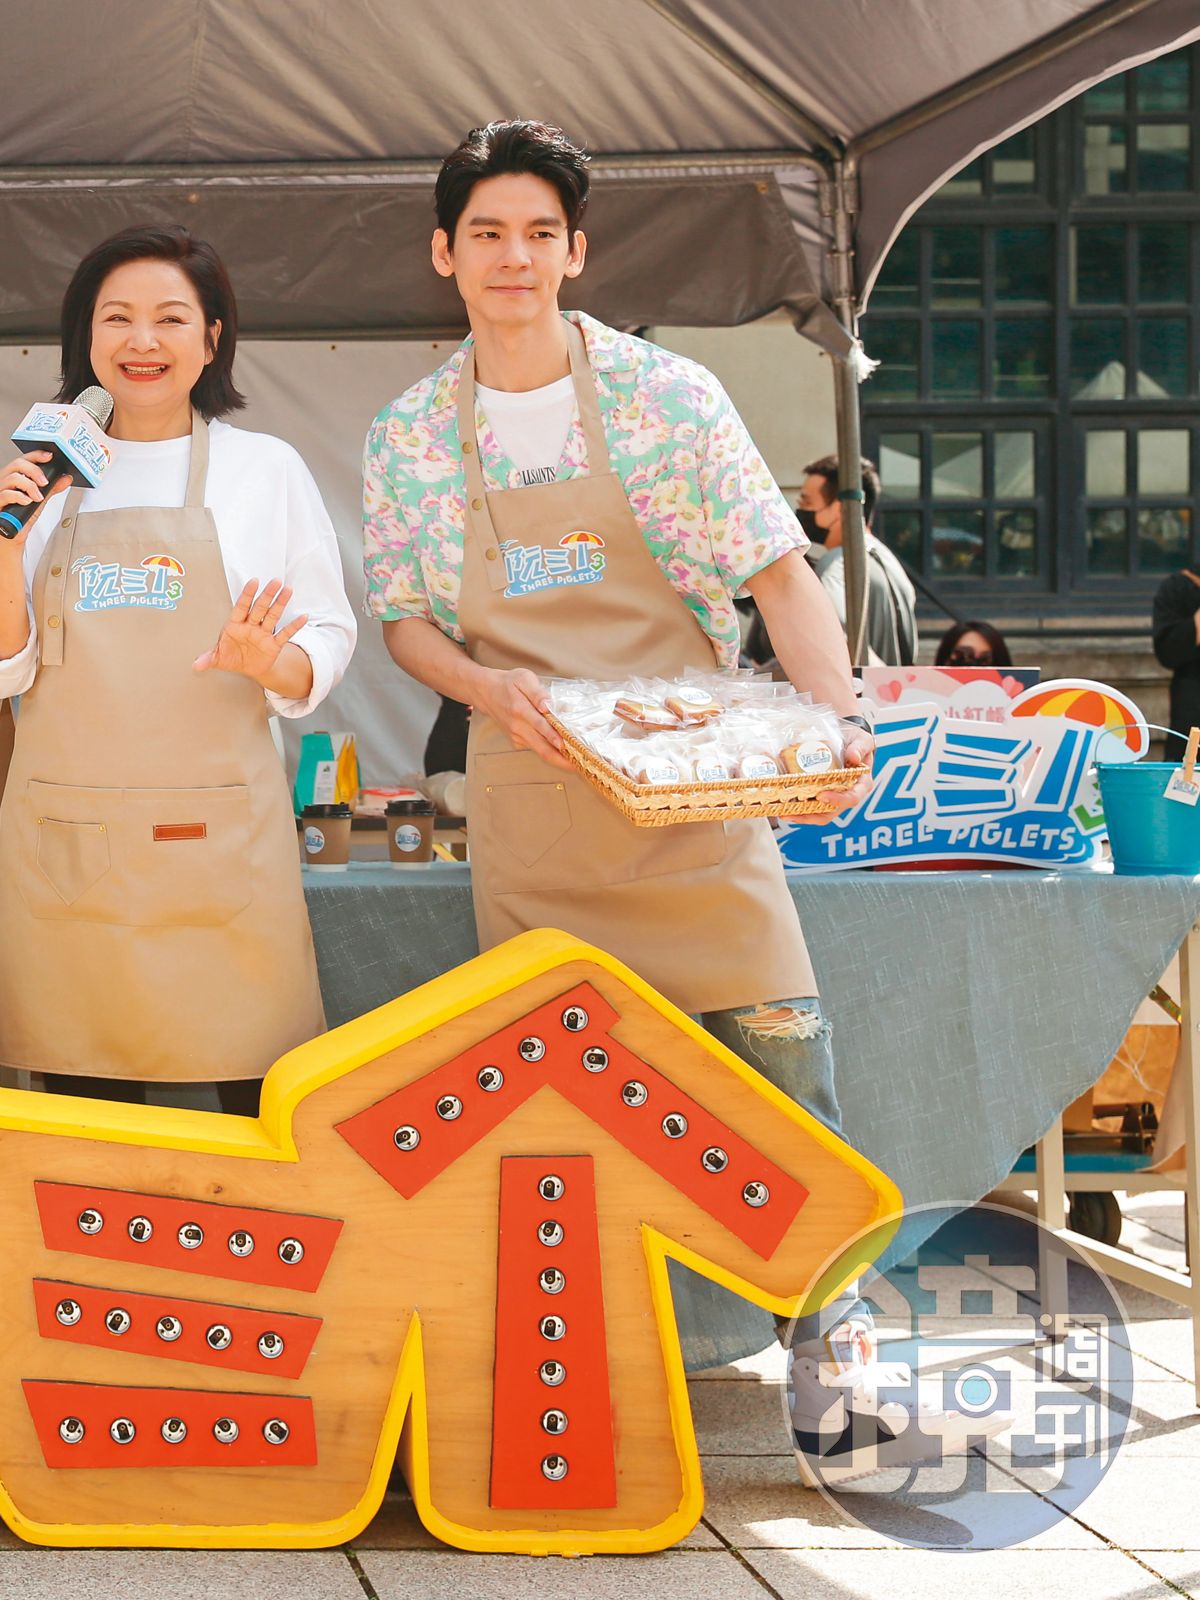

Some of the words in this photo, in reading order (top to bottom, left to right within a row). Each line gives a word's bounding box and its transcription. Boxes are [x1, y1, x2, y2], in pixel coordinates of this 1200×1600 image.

[520, 576, 554, 592] THREE
[557, 571, 596, 585] PIGLETS
[91, 595, 126, 608] THREE
[129, 596, 170, 607] PIGLETS
[821, 822, 935, 858] THREE
[948, 822, 1077, 851] PIGLETS
